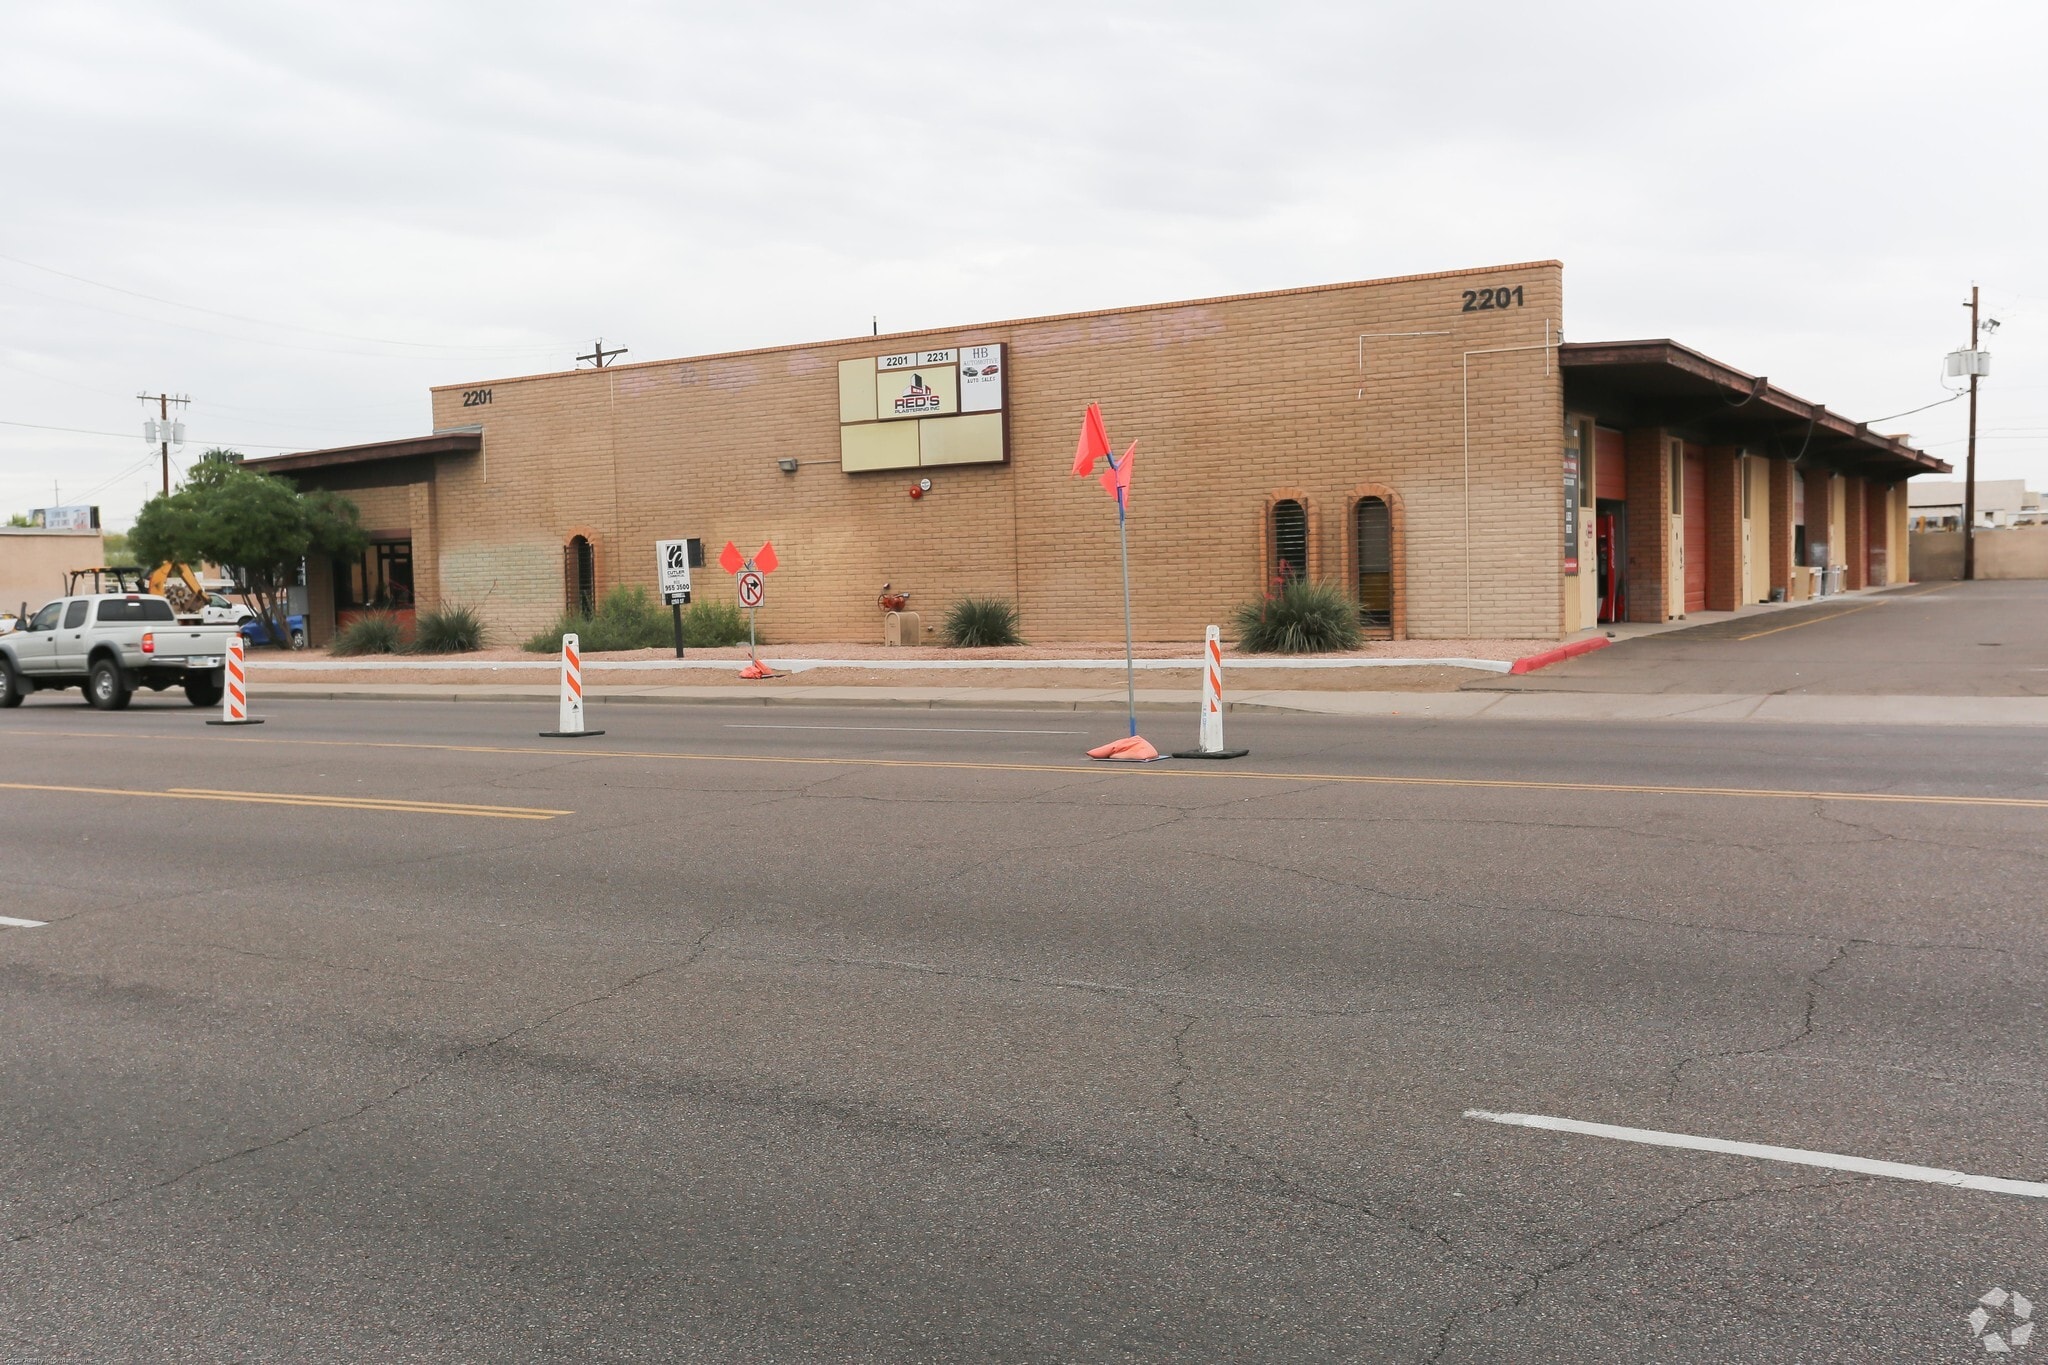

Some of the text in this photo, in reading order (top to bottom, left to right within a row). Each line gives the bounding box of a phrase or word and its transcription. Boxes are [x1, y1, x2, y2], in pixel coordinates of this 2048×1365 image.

[1462, 285, 1523, 312] 2201
[927, 352, 949, 362] 2231
[973, 347, 988, 359] HB
[886, 356, 908, 366] 2201
[463, 389, 492, 407] 2201
[895, 395, 940, 410] RED'S
